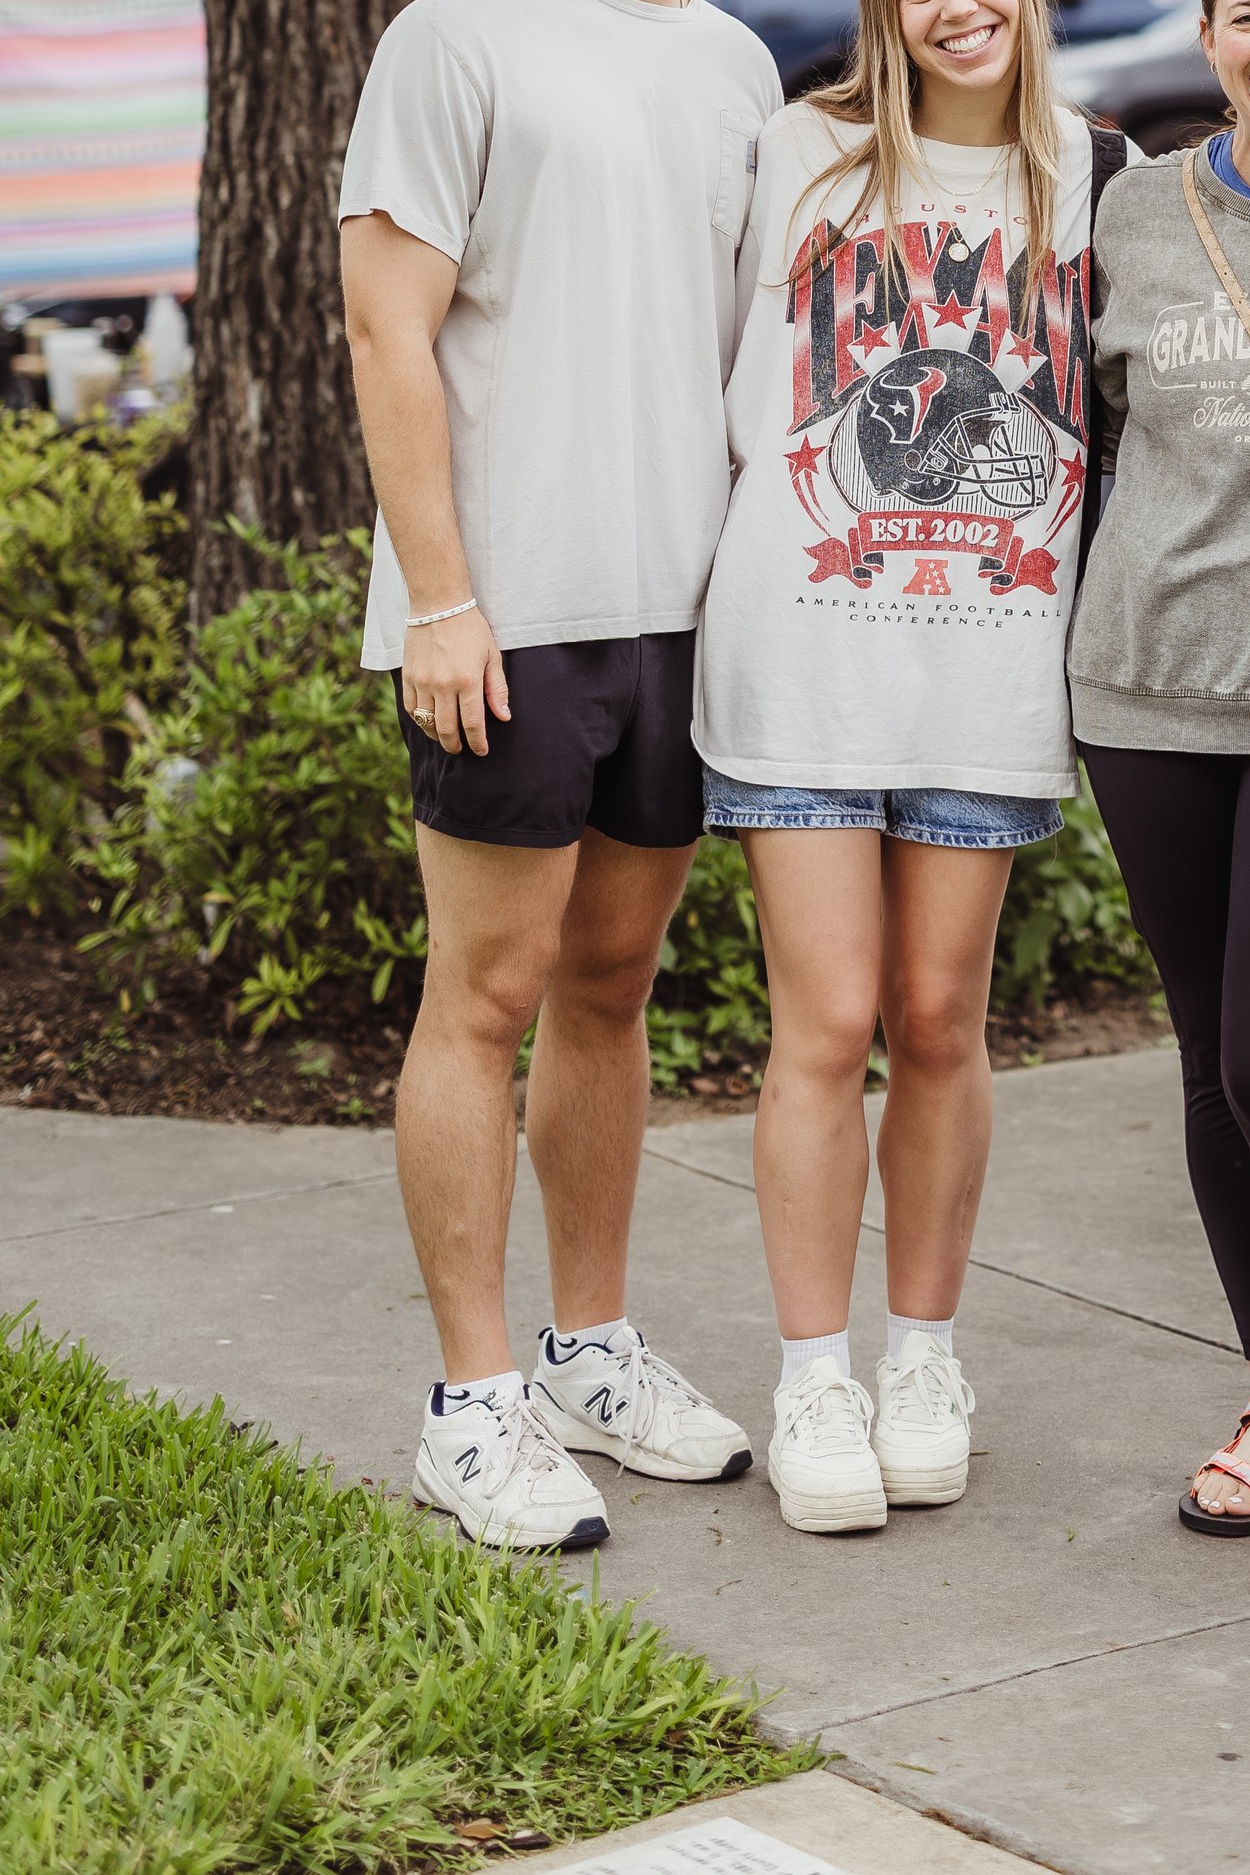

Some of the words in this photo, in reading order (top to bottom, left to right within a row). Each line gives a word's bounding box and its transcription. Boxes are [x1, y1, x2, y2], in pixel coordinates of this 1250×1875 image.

[855, 203, 1028, 226] HOUSTO
[786, 217, 1091, 449] TEXAN
[1200, 379, 1236, 390] BUILT
[870, 518, 926, 543] EST.
[928, 519, 1000, 548] 2002
[795, 595, 917, 611] AMERICAN
[935, 603, 1062, 618] FOOTBALL
[849, 613, 1004, 629] CONFERENCE
